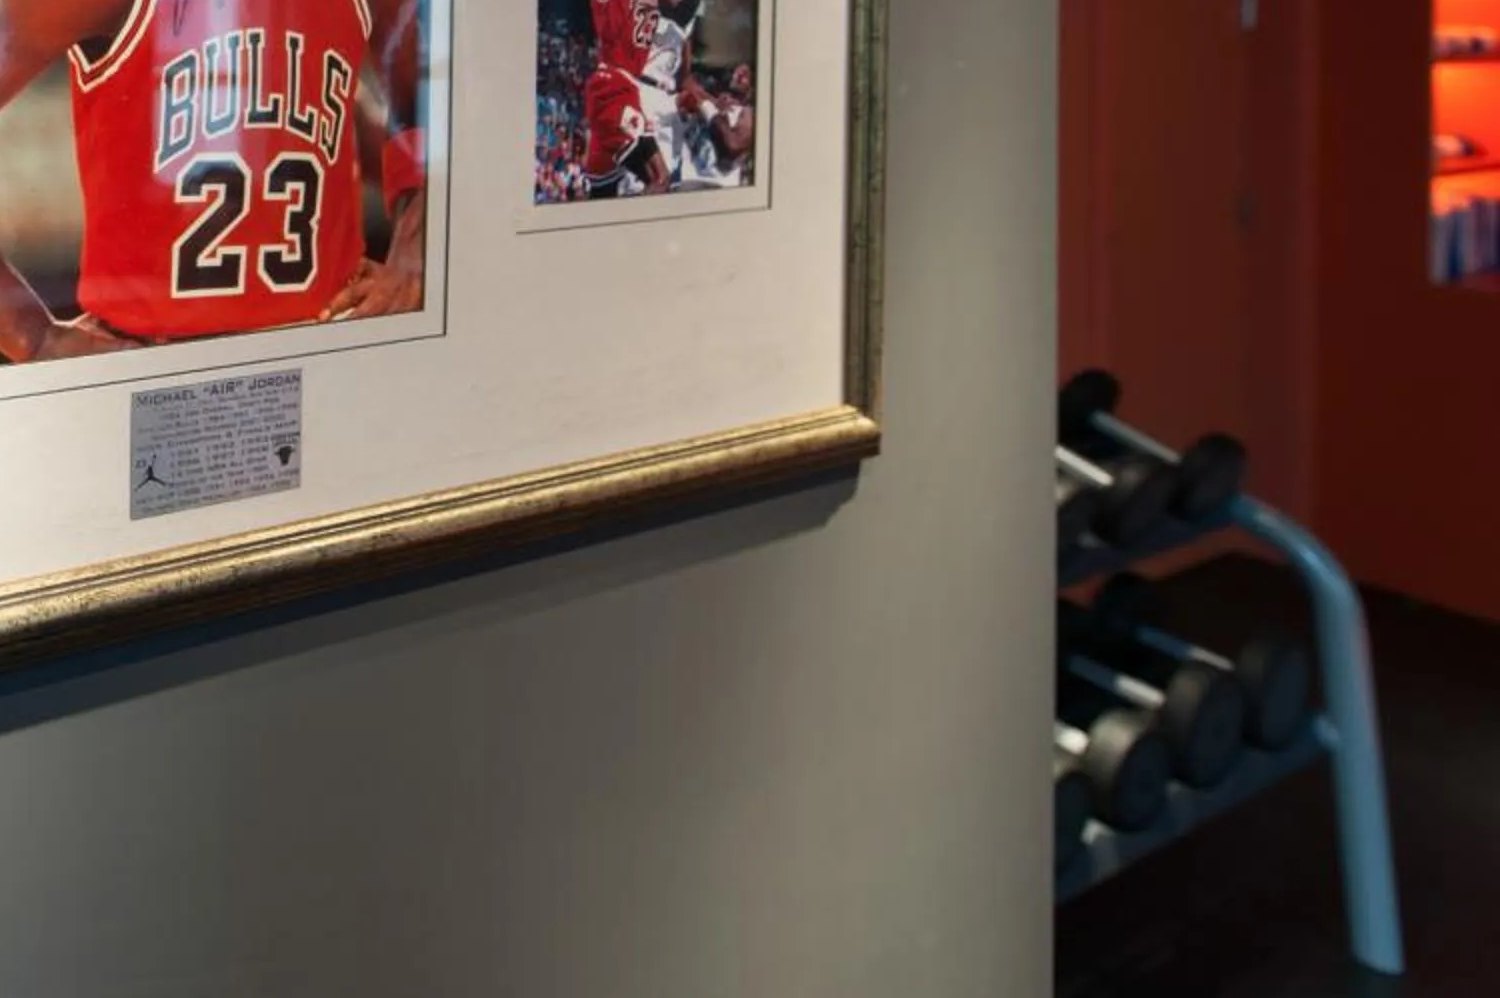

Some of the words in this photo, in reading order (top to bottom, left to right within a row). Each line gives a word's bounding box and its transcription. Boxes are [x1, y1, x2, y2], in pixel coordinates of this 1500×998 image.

[153, 26, 353, 166] BULLS
[171, 151, 325, 299] 23
[136, 389, 197, 406] MICHAEL
[248, 374, 301, 391] JORDAN
